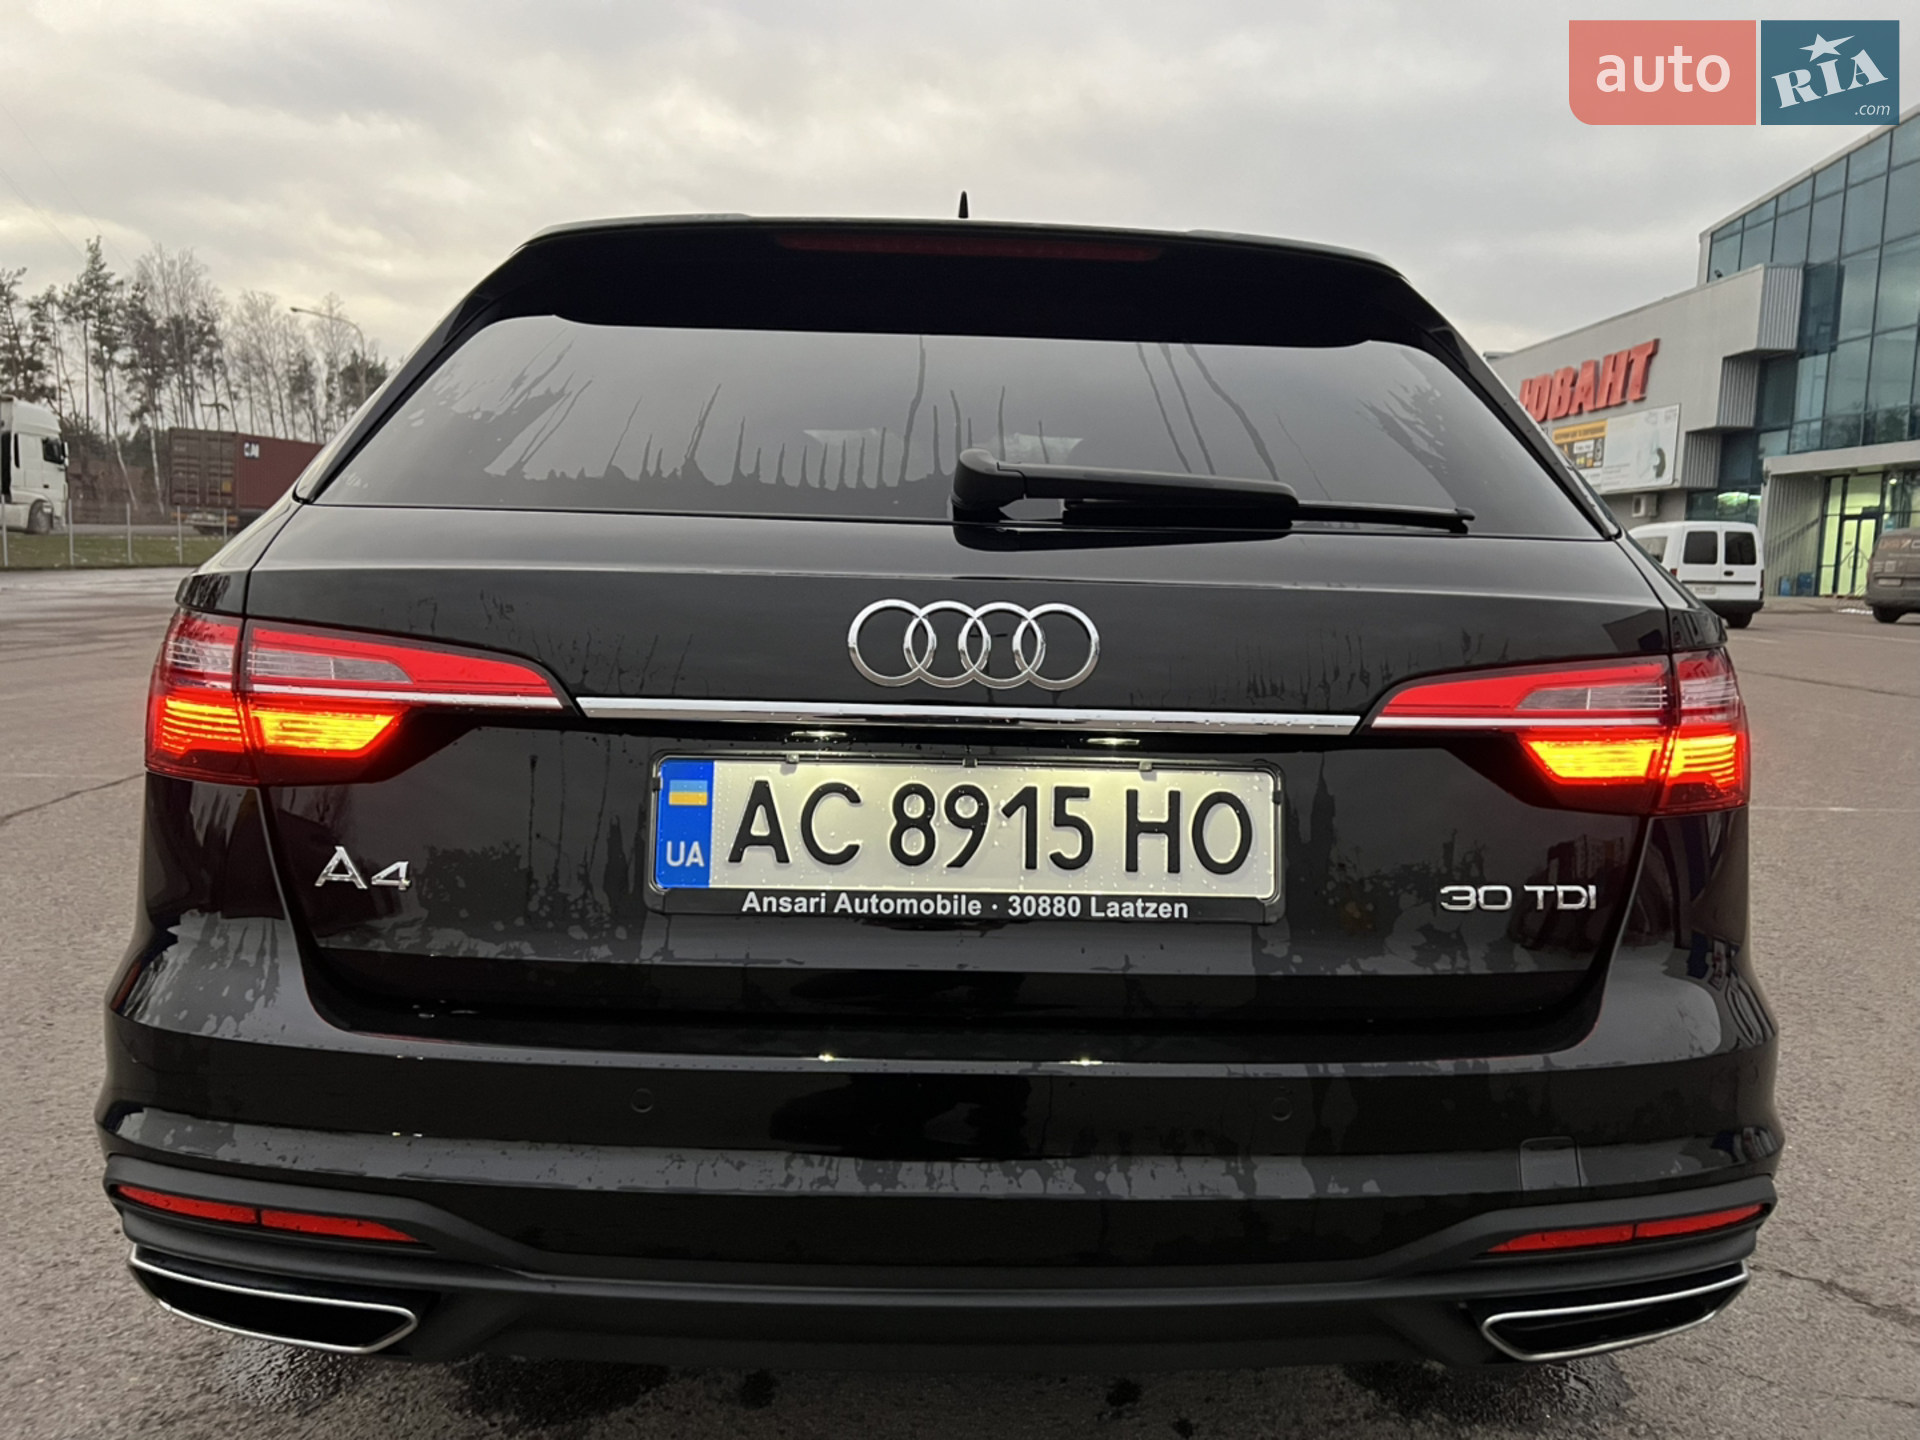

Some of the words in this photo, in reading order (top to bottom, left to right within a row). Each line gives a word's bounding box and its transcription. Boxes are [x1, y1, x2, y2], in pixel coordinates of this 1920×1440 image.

[728, 780, 863, 866] AC
[890, 784, 1095, 871] 8915
[1125, 789, 1253, 875] HO
[314, 845, 411, 890] A4
[665, 841, 705, 868] UA
[742, 891, 826, 913] Ansari
[834, 892, 982, 916] Automobile
[1008, 895, 1082, 918] 30880
[1090, 897, 1189, 919] Laatzen
[1440, 885, 1512, 911] 30
[1524, 885, 1597, 910] TDI
